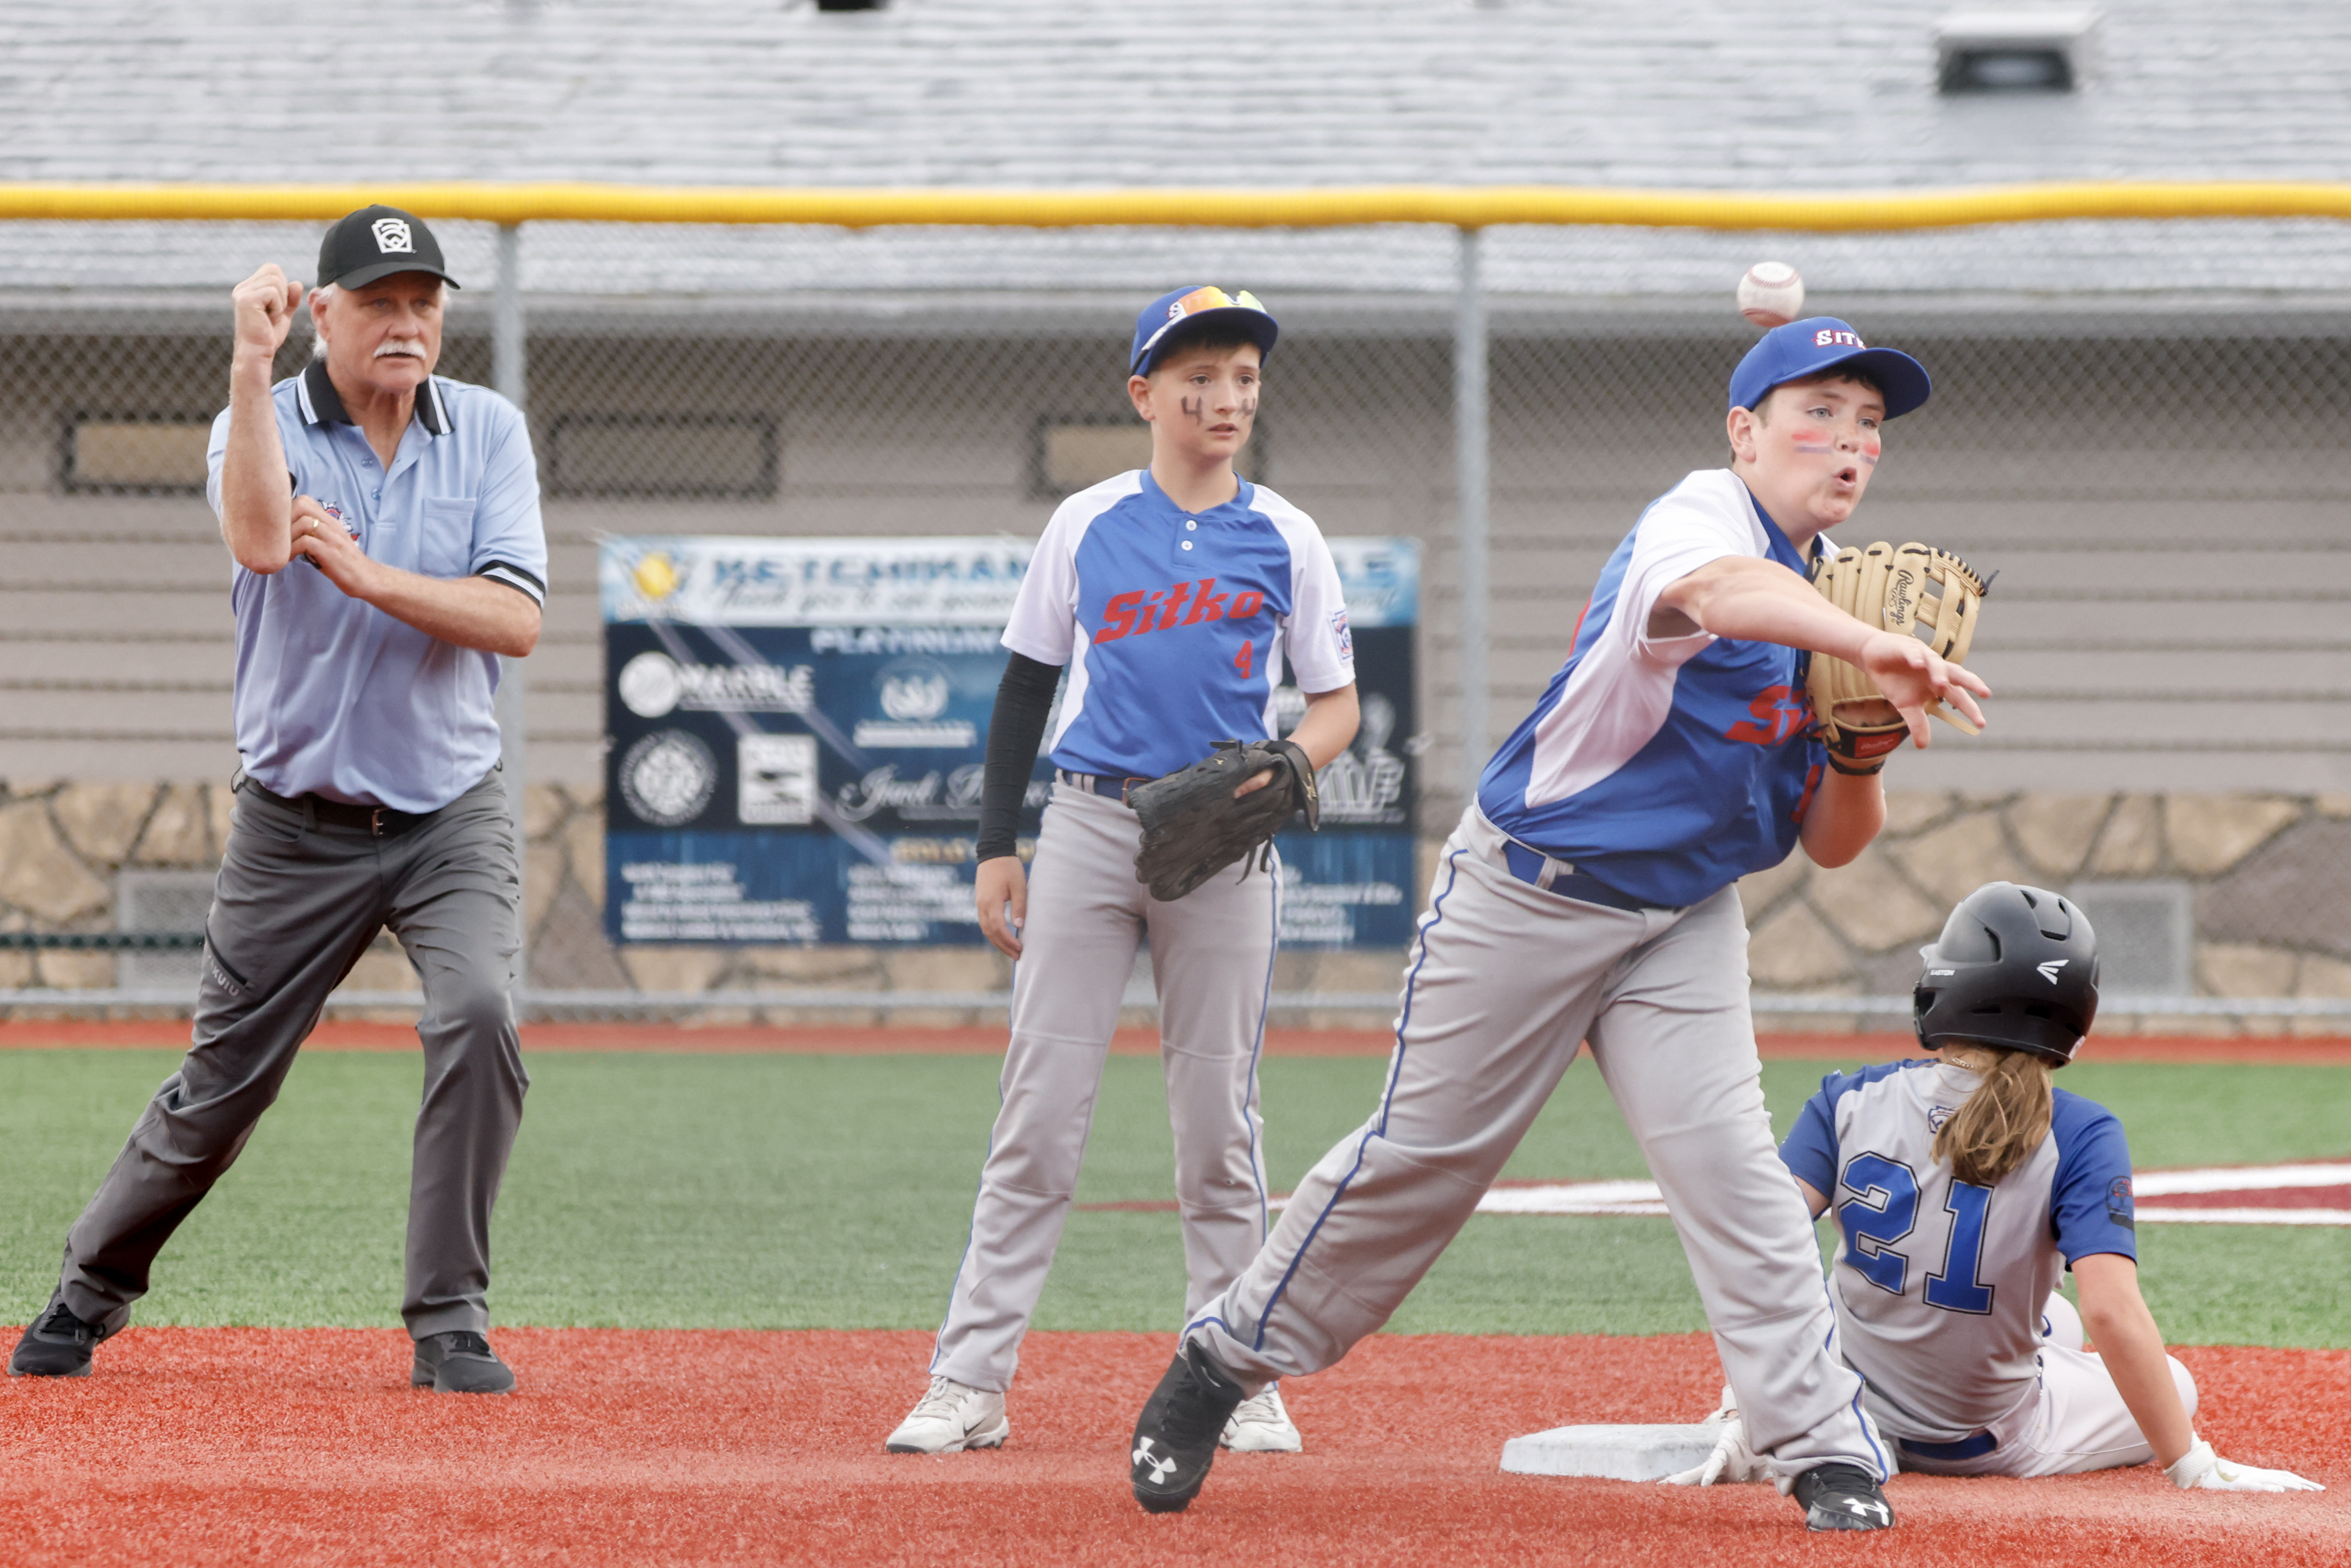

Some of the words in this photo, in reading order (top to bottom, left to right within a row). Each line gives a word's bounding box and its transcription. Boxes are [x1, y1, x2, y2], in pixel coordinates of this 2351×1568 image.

[1181, 396, 1203, 425] 4
[1889, 569, 1914, 626] Rawlings
[1234, 640, 1253, 679] 4
[1837, 1150, 1996, 1316] 21
